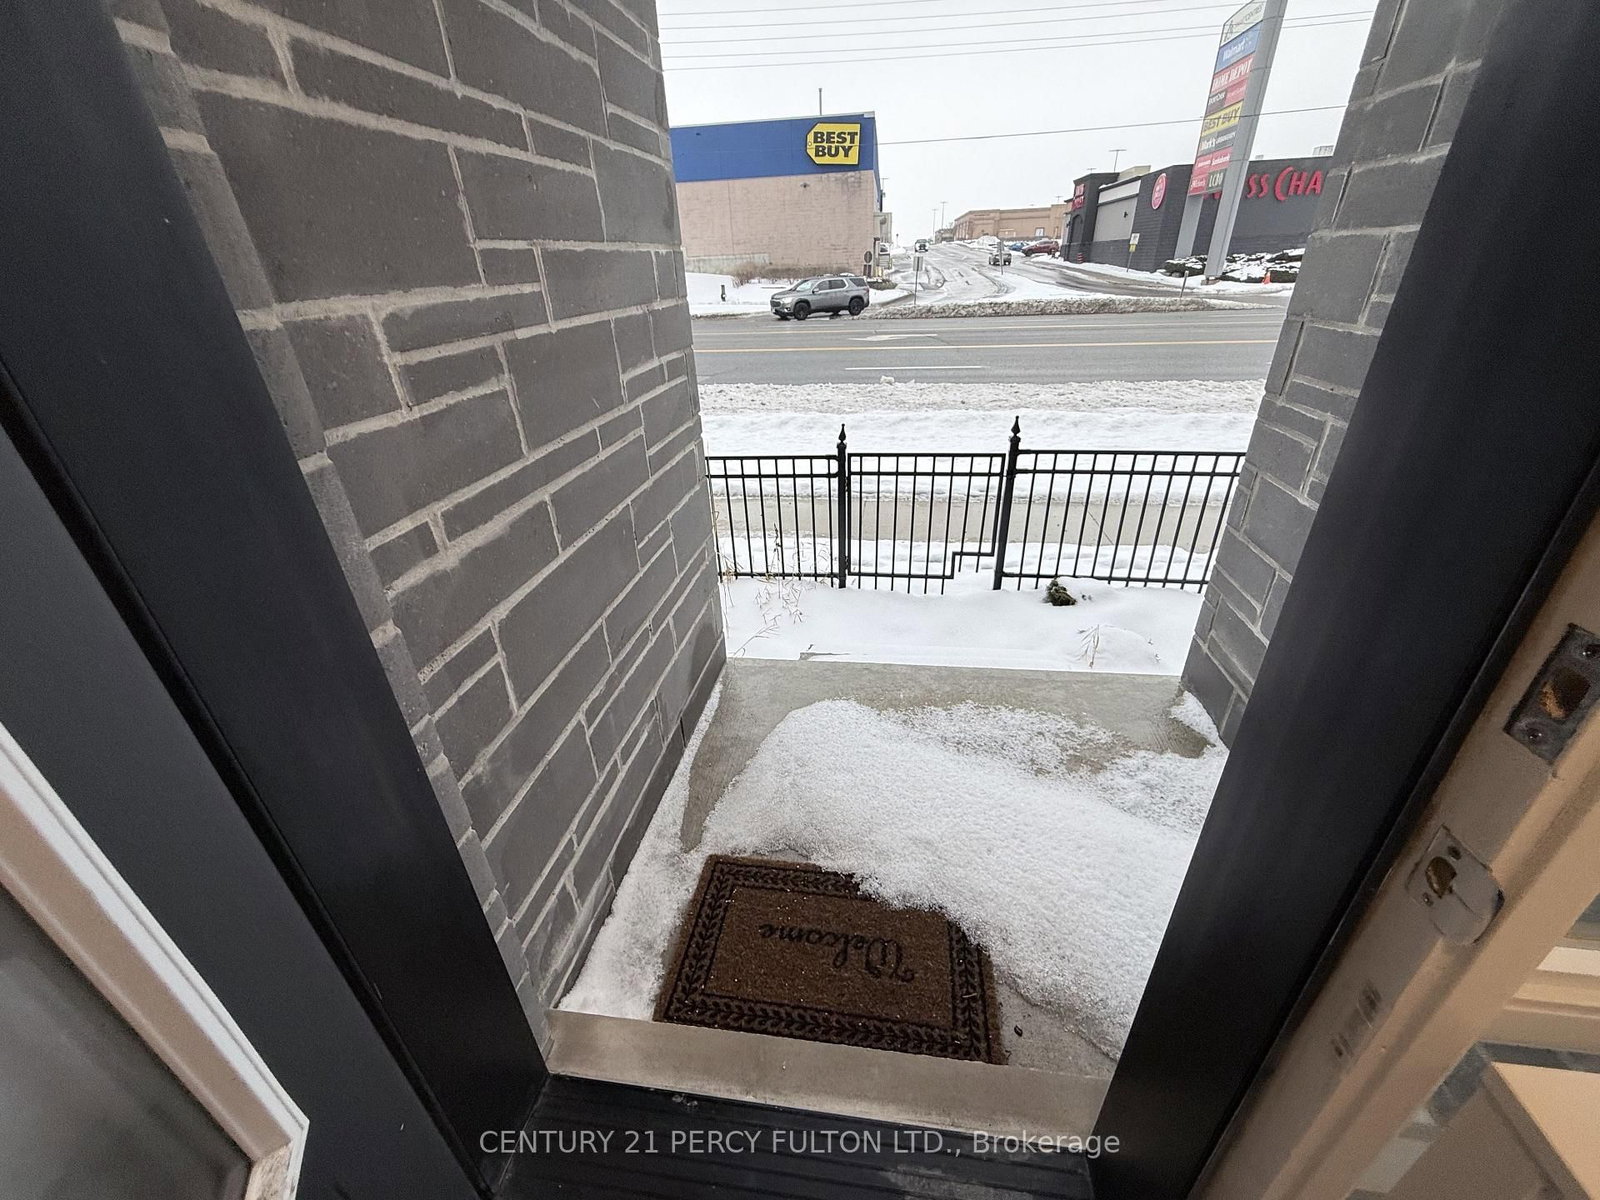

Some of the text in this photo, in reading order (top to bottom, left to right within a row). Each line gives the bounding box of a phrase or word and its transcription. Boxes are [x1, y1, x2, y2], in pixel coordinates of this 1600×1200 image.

[1229, 57, 1254, 81] DEPOT
[1203, 105, 1241, 132] BEST BUY
[813, 131, 858, 144] BEST
[814, 145, 854, 158] BUY
[758, 923, 915, 982] Welcome
